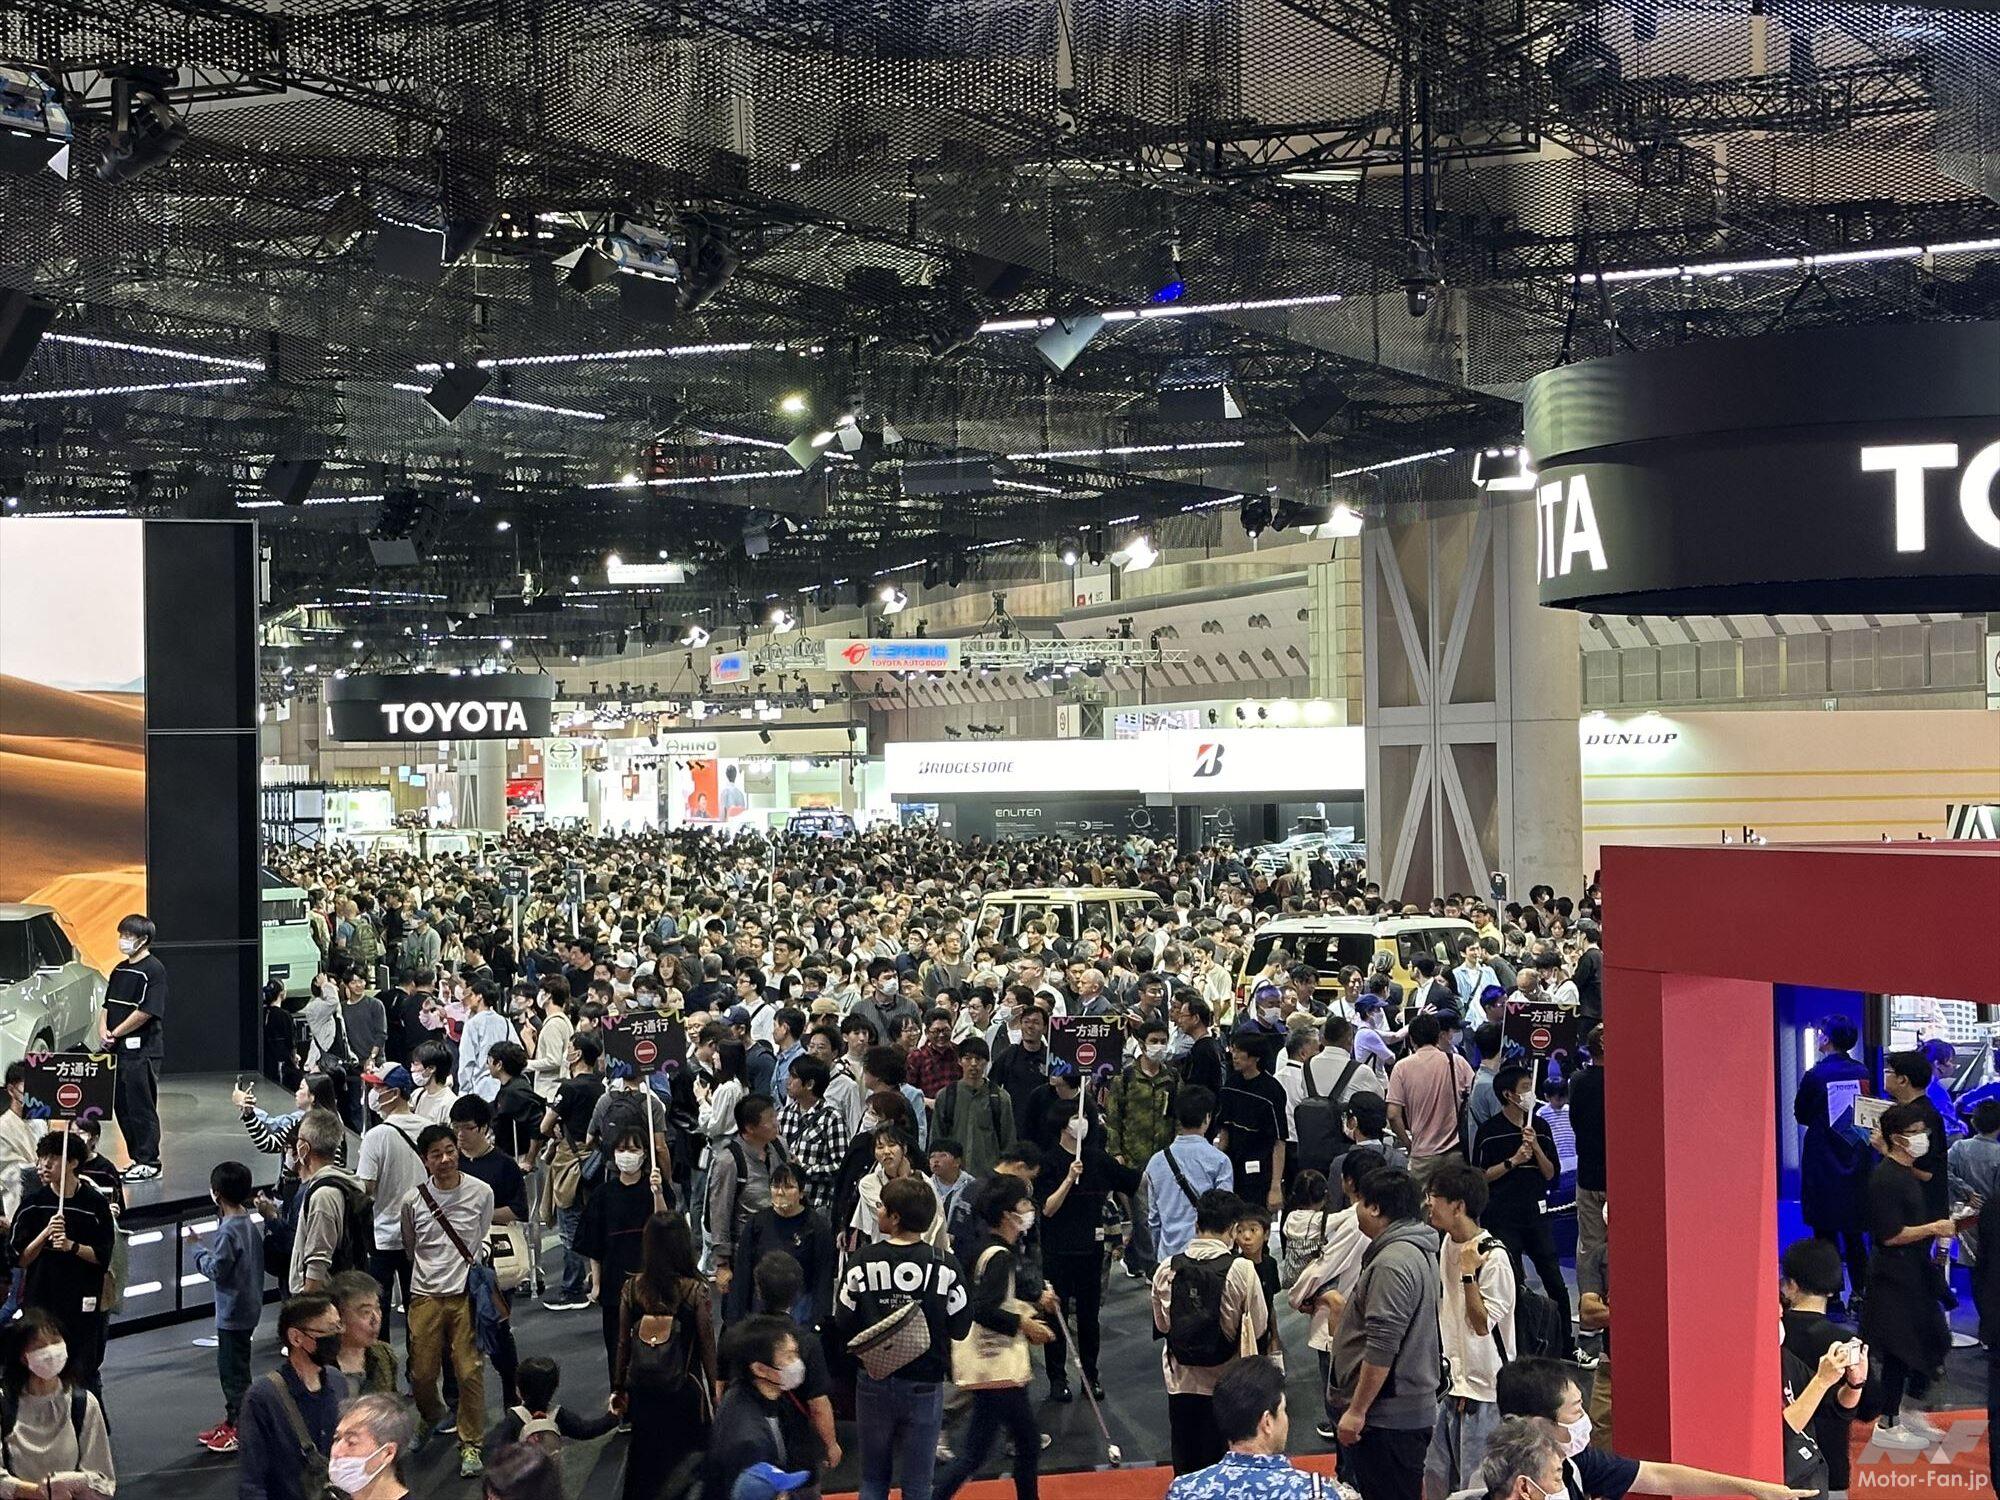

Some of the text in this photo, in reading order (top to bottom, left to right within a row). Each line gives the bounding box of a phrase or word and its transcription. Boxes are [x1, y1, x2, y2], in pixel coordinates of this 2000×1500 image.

[1537, 474, 1608, 586] TA
[380, 701, 528, 734] TOYOTA
[680, 740, 717, 751] HINO
[1586, 733, 1678, 745] DUNLOP
[918, 761, 1014, 775] BRIDGESTONE
[995, 808, 1042, 818] ENLITEN
[1519, 1009, 1566, 1024] 一方通行
[618, 1018, 669, 1036] 一方通行
[1064, 1024, 1111, 1038] 一方通行
[42, 1061, 99, 1077] 一方通行
